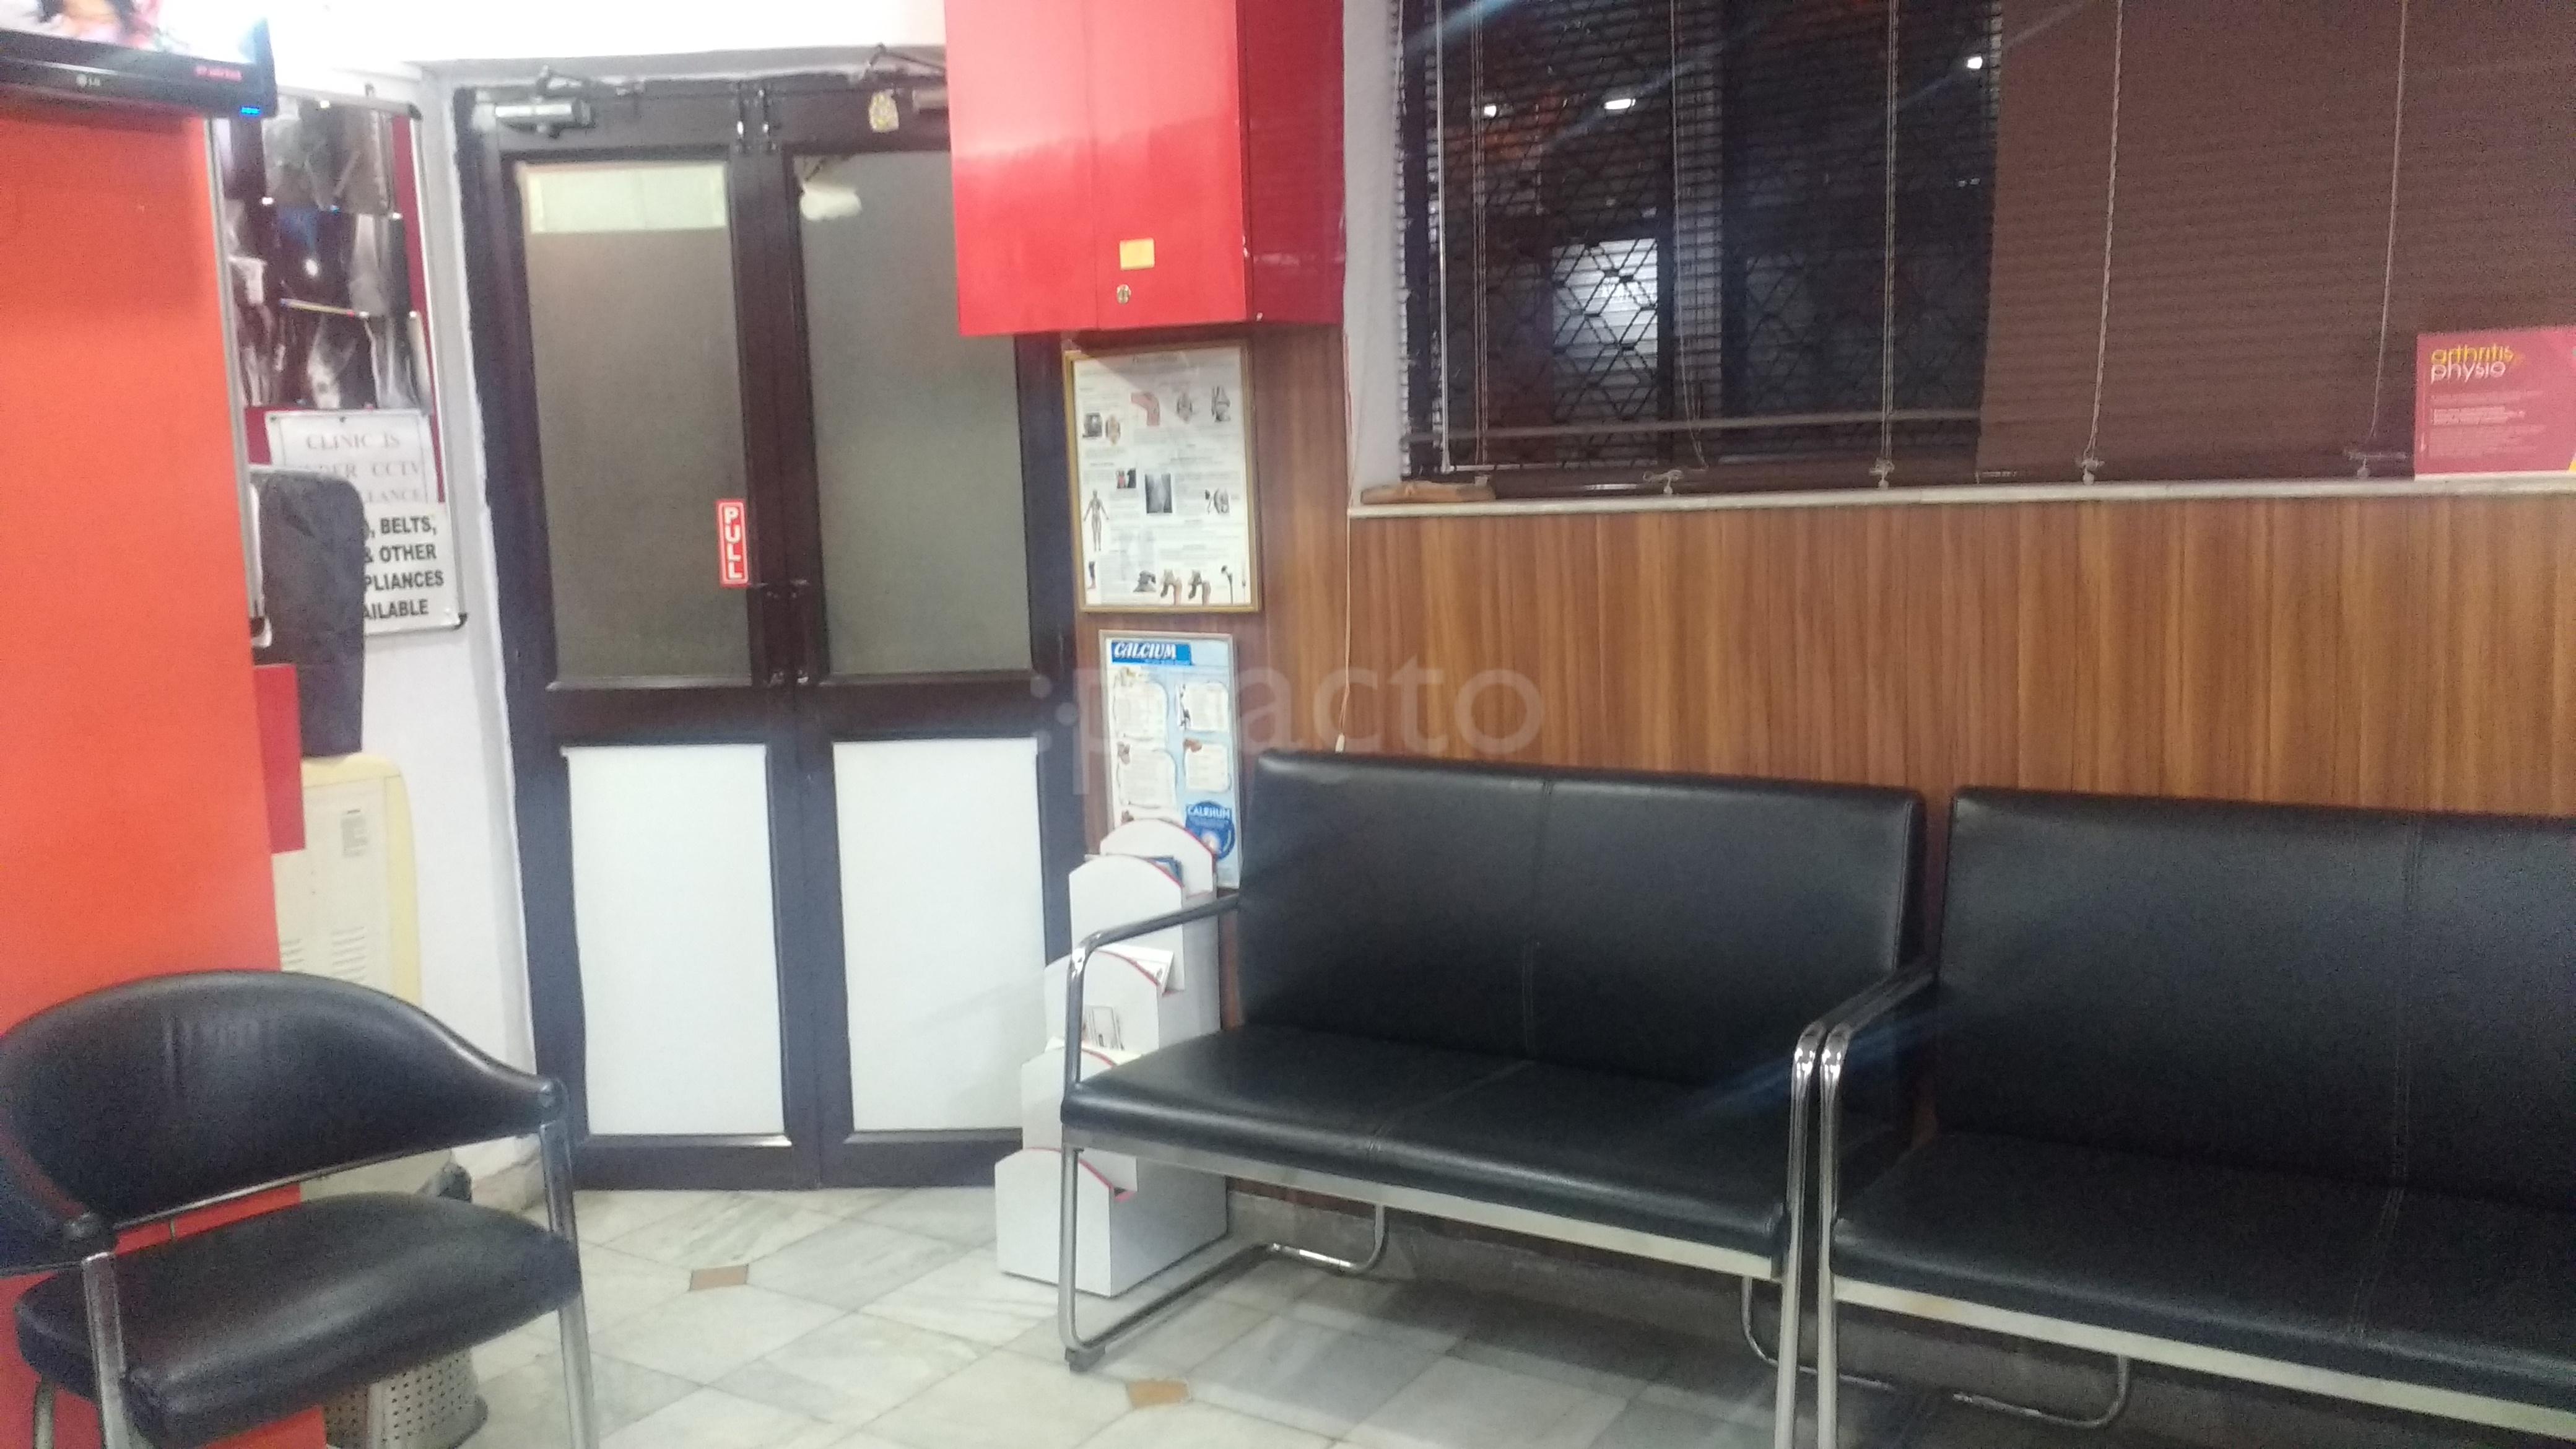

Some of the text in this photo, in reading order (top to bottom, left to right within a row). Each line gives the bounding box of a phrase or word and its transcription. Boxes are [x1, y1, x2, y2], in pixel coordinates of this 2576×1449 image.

[2431, 360, 2505, 385] physio
[306, 432, 400, 450] CLINIC IS
[372, 461, 420, 476] CCTV
[380, 516, 437, 535] BELTS,
[724, 505, 744, 580] PULL
[380, 544, 436, 562] OTHER
[1114, 642, 1176, 660] CALCIUM
